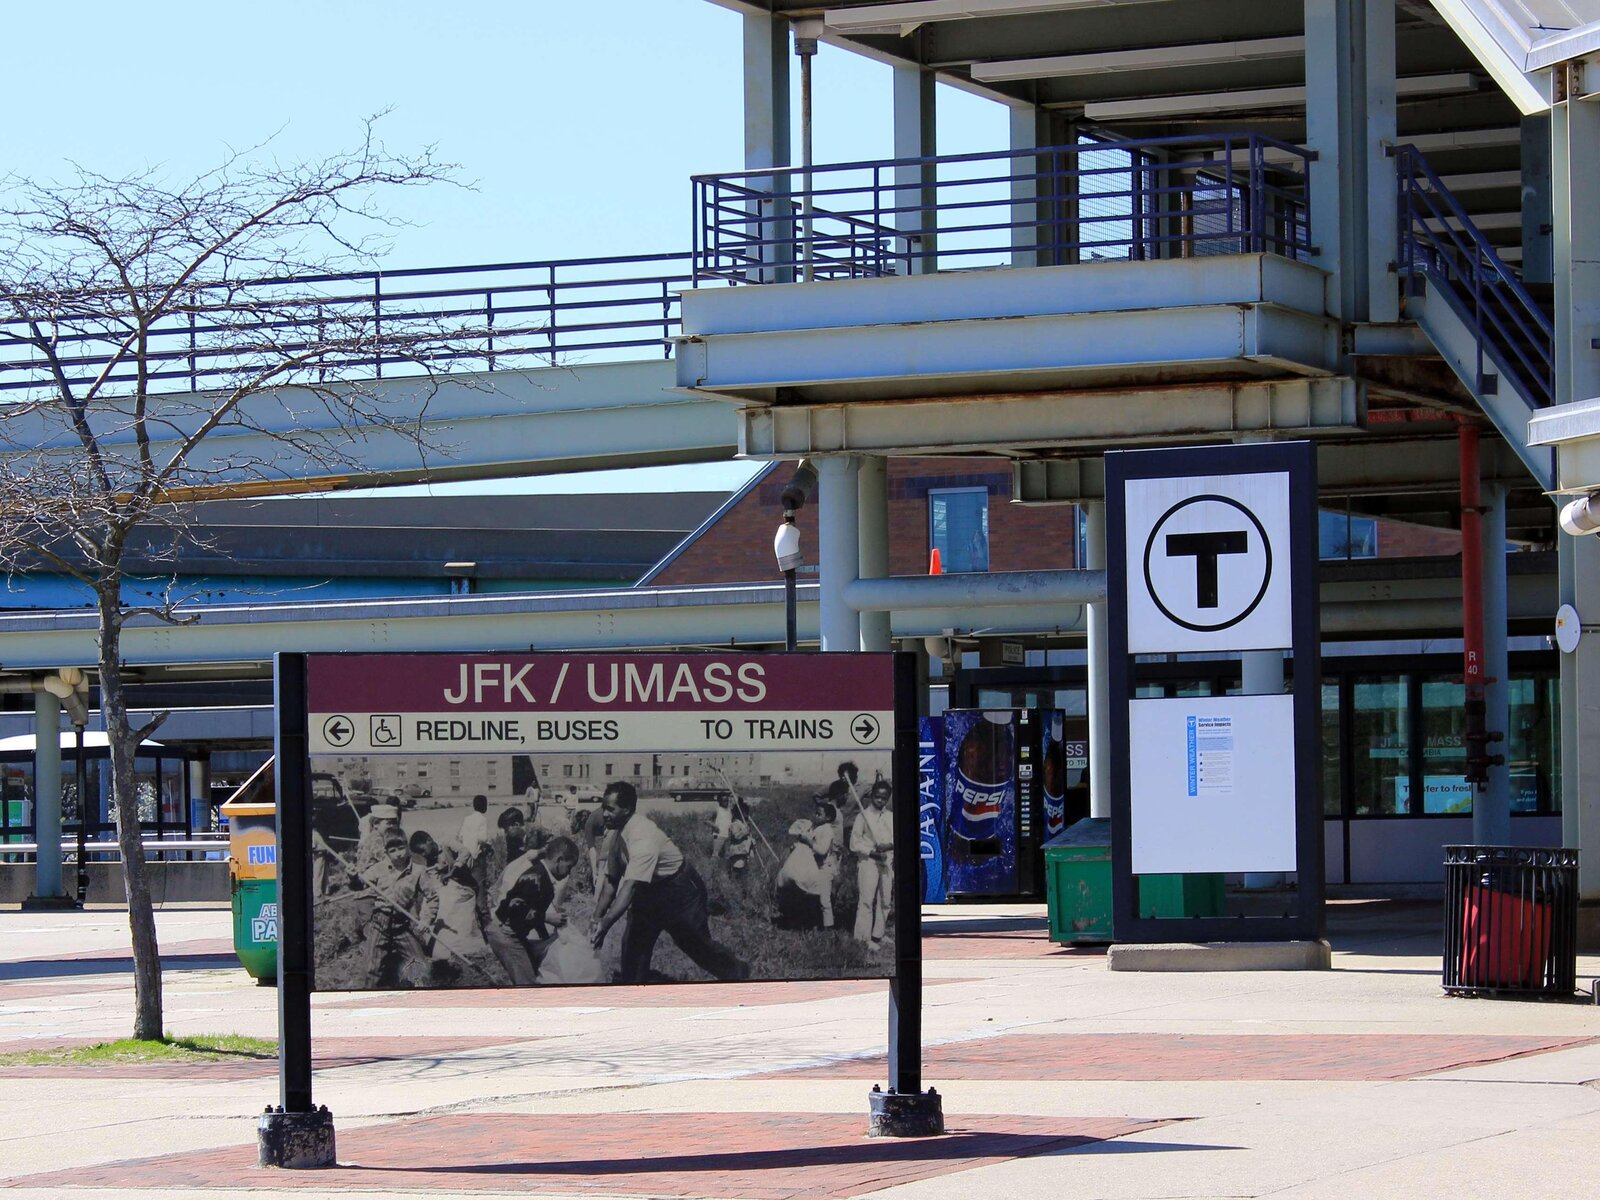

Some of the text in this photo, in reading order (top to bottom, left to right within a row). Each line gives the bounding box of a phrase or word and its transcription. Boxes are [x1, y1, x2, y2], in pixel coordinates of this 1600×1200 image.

[1166, 531, 1248, 608] T
[1468, 651, 1476, 661] R
[1468, 665, 1478, 675] 40
[444, 662, 767, 704] JFK / UMASS
[416, 720, 619, 744] REDLINE, BUSES
[701, 718, 835, 740] TO TRAINS
[1066, 744, 1084, 756] SS
[1188, 729, 1196, 764] WEATHER
[1427, 736, 1462, 748] MASS
[955, 779, 1006, 807] PEPSI
[1441, 785, 1450, 793] to
[1043, 796, 1064, 818] PEPS
[248, 846, 276, 864] FUN
